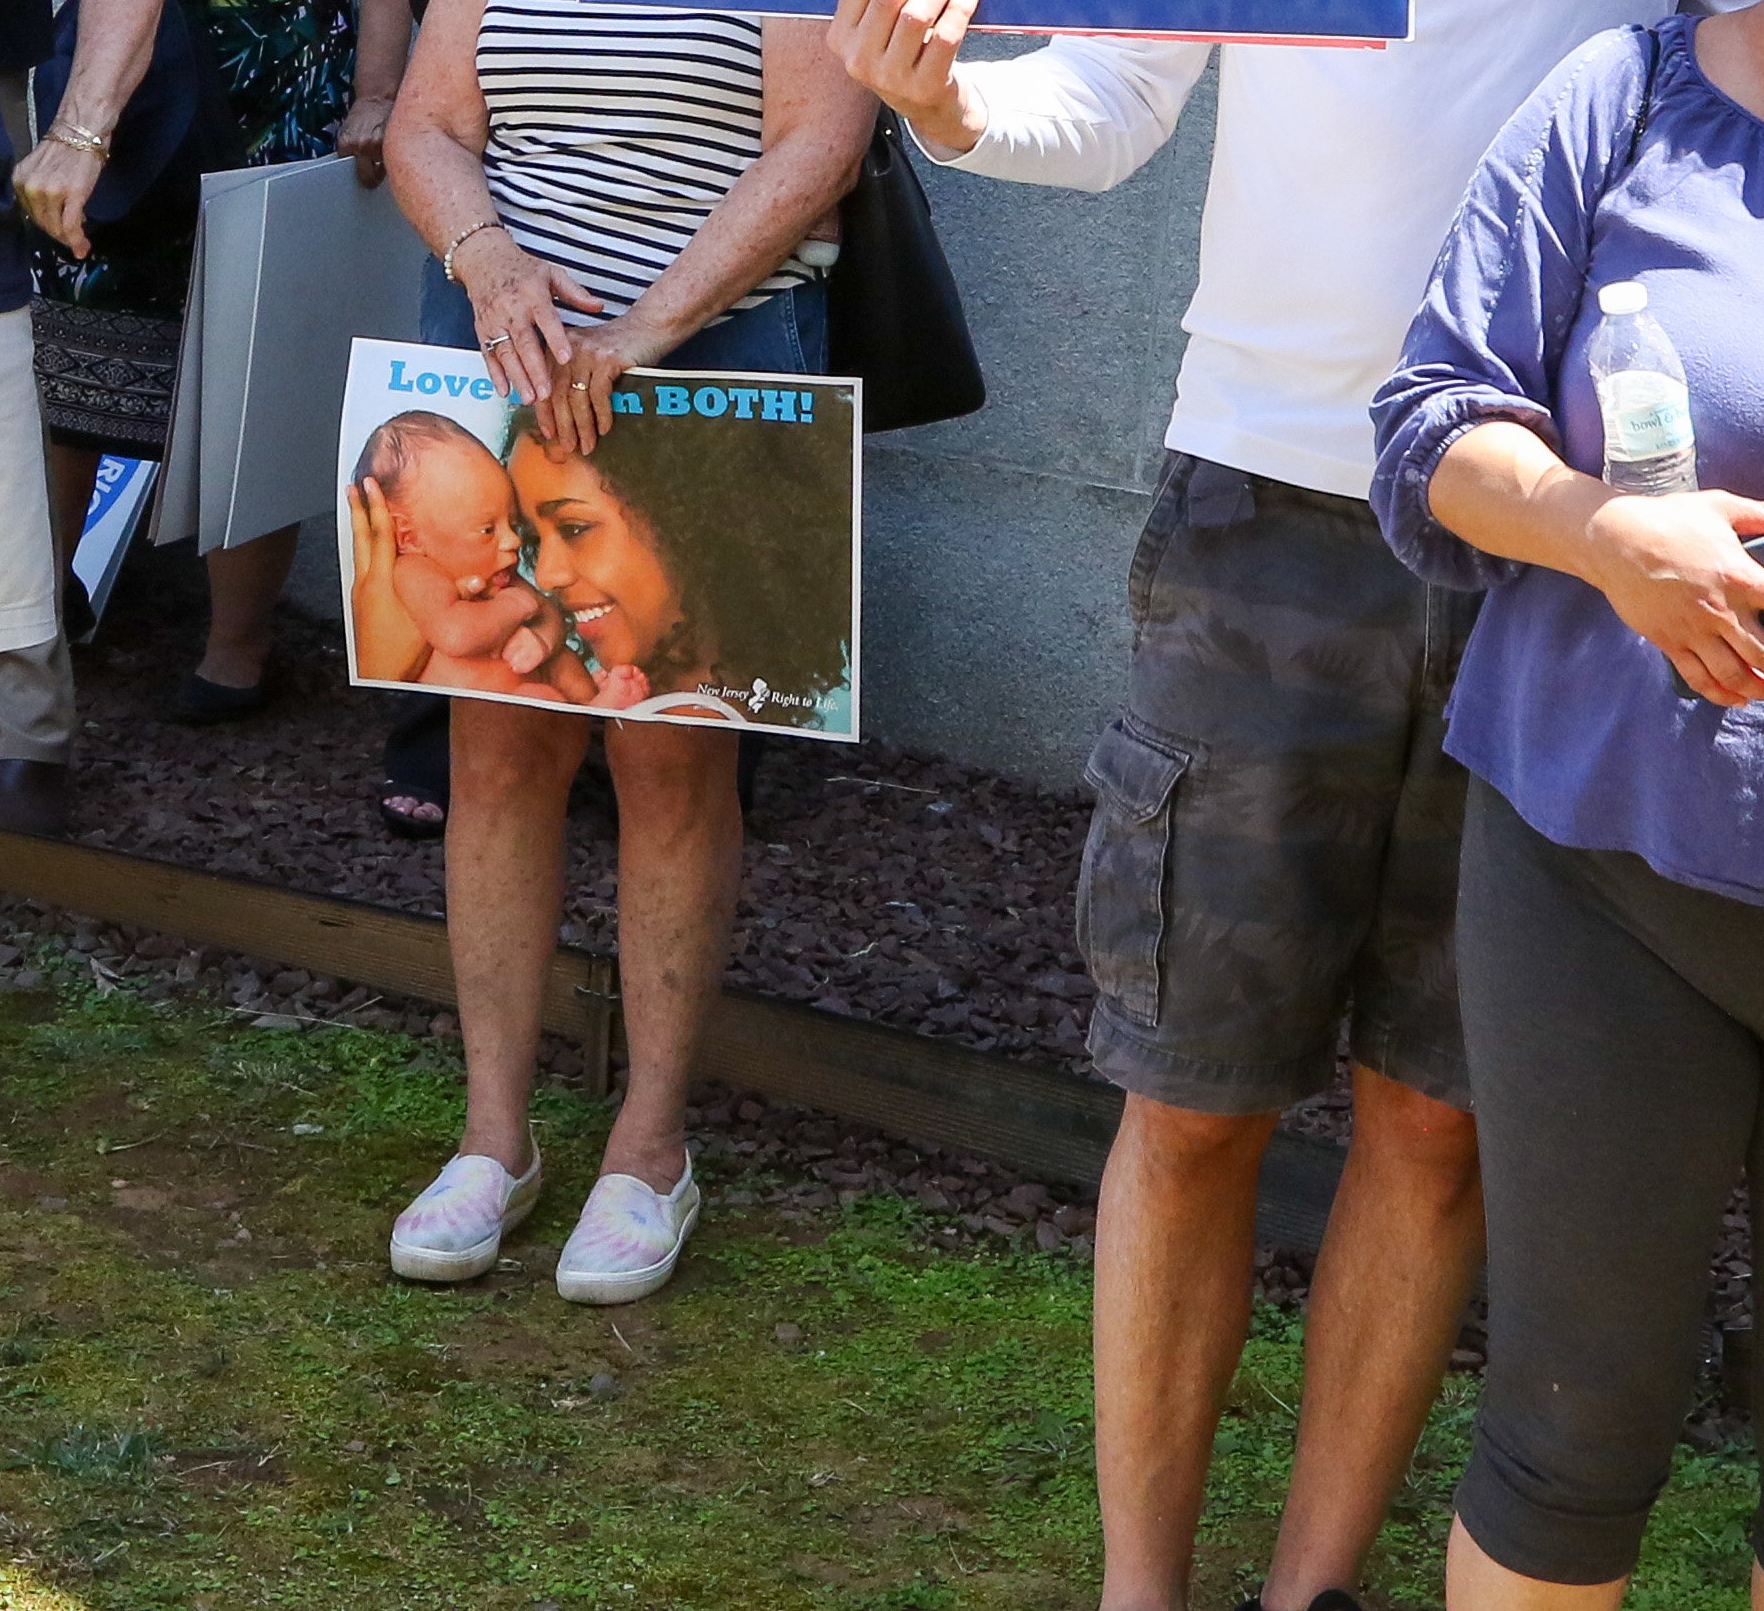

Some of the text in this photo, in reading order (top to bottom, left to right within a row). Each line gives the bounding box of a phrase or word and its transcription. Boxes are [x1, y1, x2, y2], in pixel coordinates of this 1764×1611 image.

[388, 360, 494, 401] Love
[655, 384, 815, 423] BOTH!
[721, 686, 749, 700] Jersey
[771, 692, 800, 707] Right
[802, 697, 813, 707] to
